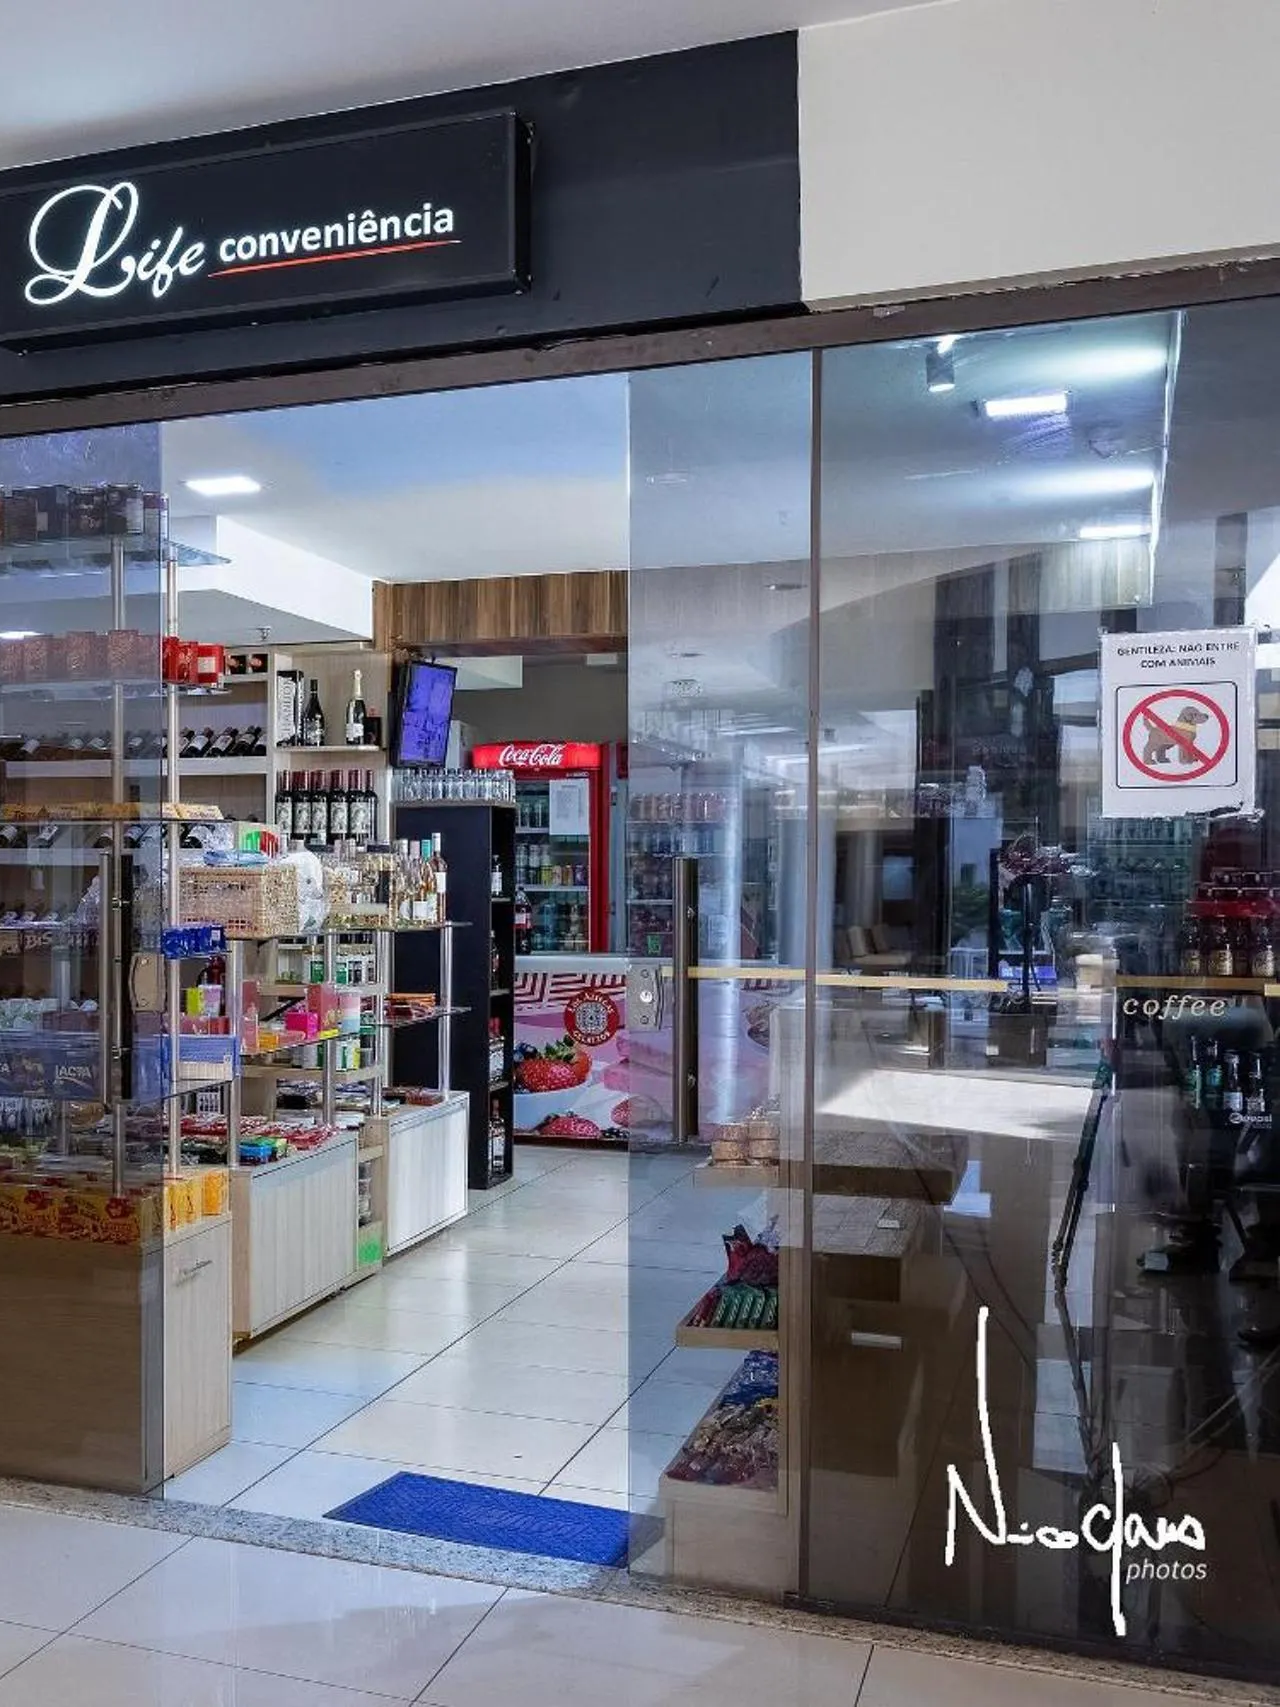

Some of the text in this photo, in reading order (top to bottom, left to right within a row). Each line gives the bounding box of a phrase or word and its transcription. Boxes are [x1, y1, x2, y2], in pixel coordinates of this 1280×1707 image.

[24, 181, 455, 305] Life conveniência
[1206, 641, 1240, 652] ENTRE
[1141, 657, 1216, 668] COM ANIMAIS
[499, 743, 566, 767] Coca-Cola
[1123, 995, 1225, 1020] coffee
[55, 1064, 92, 1079] LACTA
